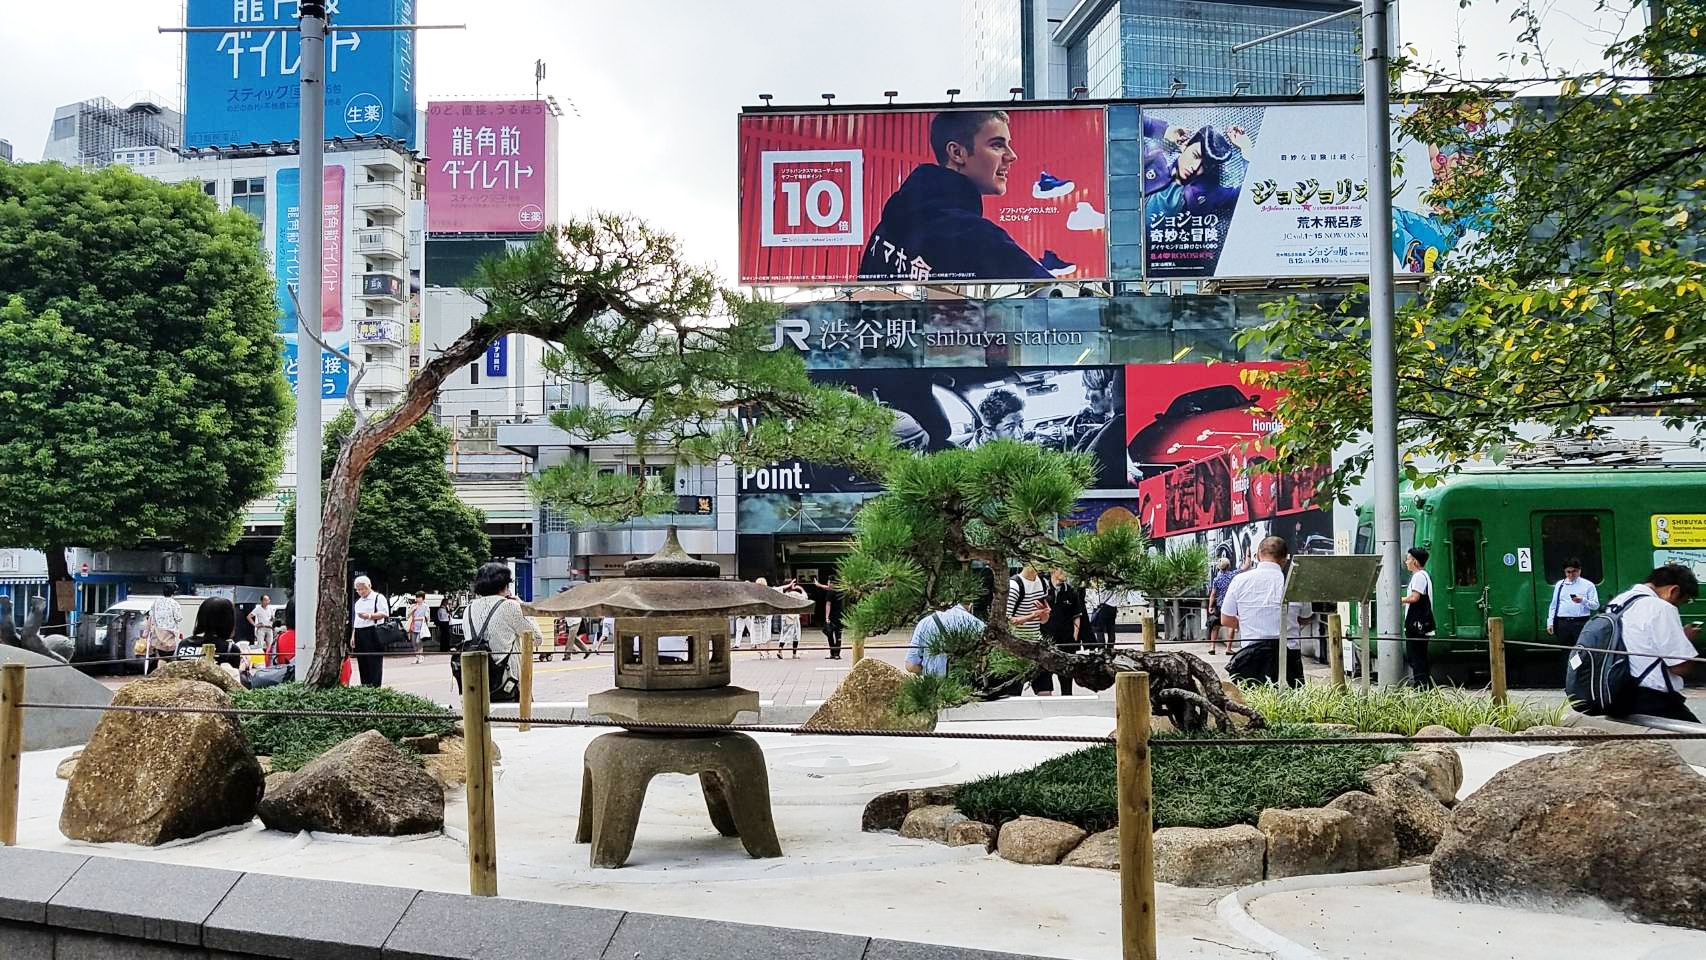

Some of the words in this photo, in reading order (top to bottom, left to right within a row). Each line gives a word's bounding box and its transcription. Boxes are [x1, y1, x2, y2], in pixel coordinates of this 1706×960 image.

[216, 25, 360, 79] ダイレト
[346, 104, 381, 123] 生薬
[452, 126, 520, 156] 龍角散
[442, 160, 534, 189] ダイレクト
[781, 180, 844, 227] 10
[520, 211, 541, 222] 生薬
[839, 220, 850, 231] 倍
[1150, 211, 1219, 228] ジョジョの
[1296, 215, 1362, 229] 荒木飛呂彦
[1150, 228, 1219, 242] 奇妙な冒険
[756, 319, 810, 350] JR
[820, 319, 918, 350] 渋谷駅
[927, 330, 1008, 347] shibuya
[1014, 329, 1083, 345] station
[742, 460, 810, 490] Point.
